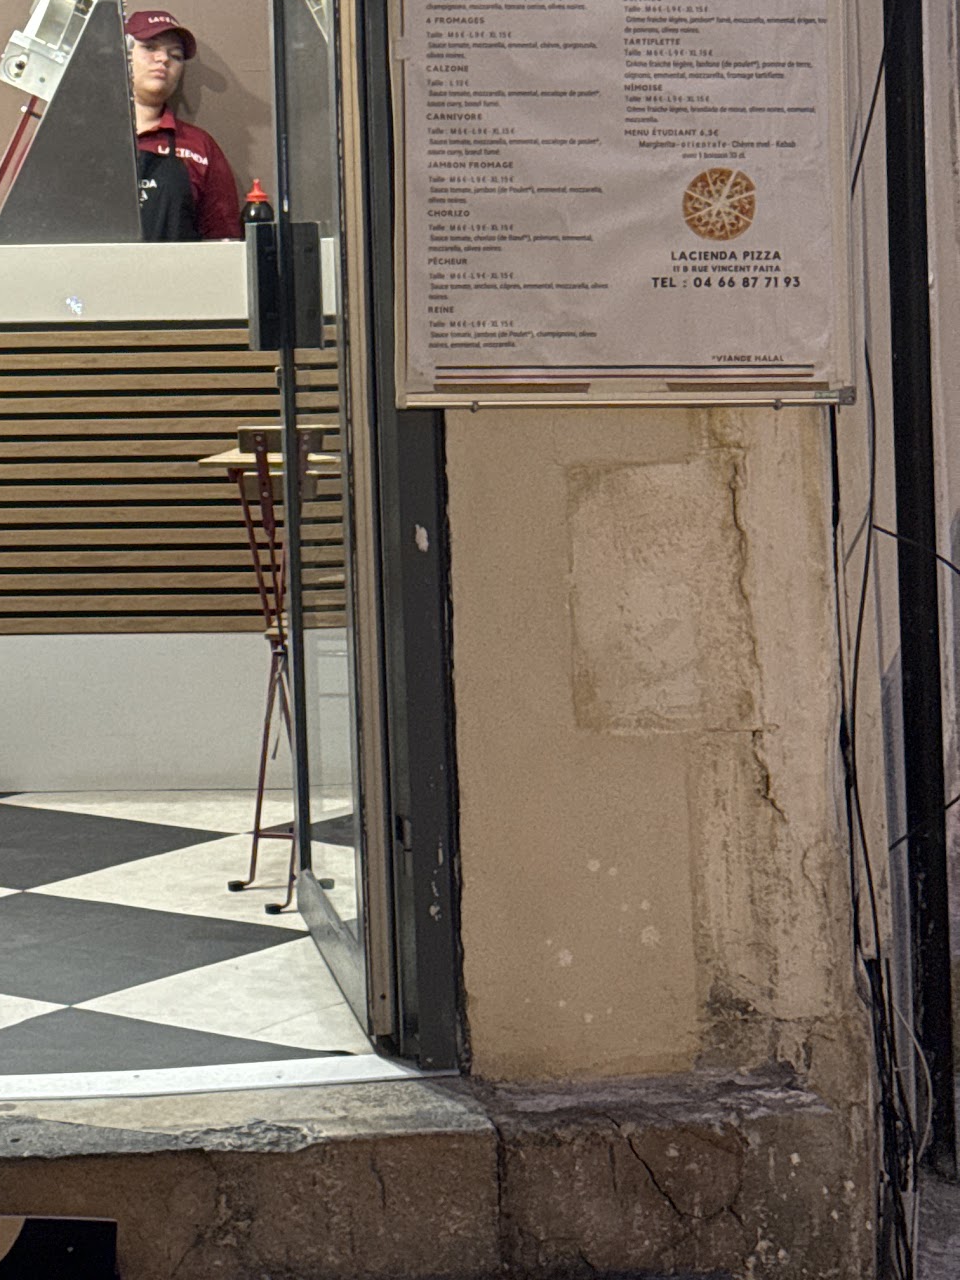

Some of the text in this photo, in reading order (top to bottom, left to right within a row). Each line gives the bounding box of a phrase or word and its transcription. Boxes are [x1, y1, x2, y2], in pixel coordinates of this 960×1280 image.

[468, 161, 514, 169] FROMAGE
[671, 251, 780, 261] LACIENDA PIZZA
[651, 277, 677, 288] TEL
[694, 277, 711, 287] 04
[718, 277, 735, 287] 66
[742, 277, 757, 288] 87
[765, 277, 778, 287] 71
[784, 276, 800, 287] 93
